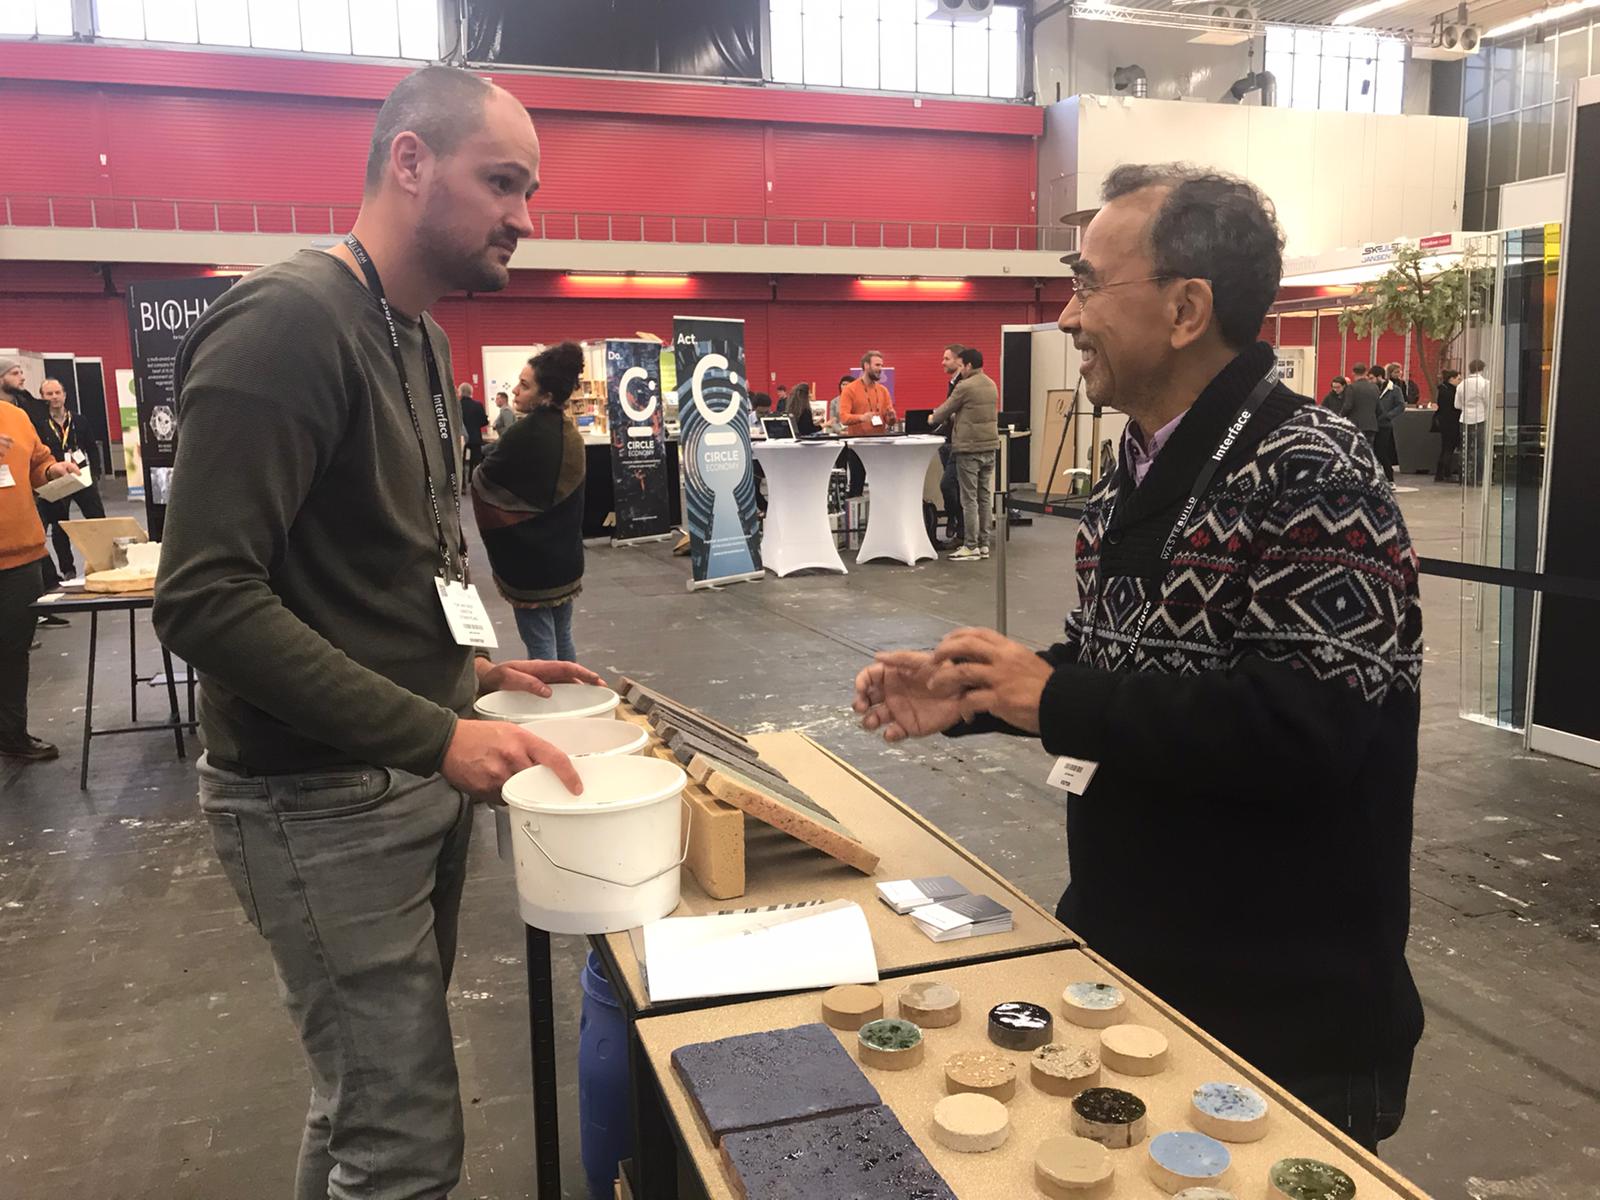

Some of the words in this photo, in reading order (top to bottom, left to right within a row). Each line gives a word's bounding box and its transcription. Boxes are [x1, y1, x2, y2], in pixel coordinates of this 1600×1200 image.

[140, 298, 209, 333] BIOH
[677, 333, 698, 345] Act.
[608, 351, 623, 361] Do.
[433, 393, 448, 439] Interface
[1212, 409, 1251, 462] Interface
[627, 440, 655, 450] CIRCLE
[628, 449, 655, 457] ECONOMY
[704, 451, 740, 463] CIRCLE
[706, 463, 740, 473] ECONOMY
[1161, 496, 1197, 560] WASTEBUILD
[1128, 600, 1151, 654] Interface
